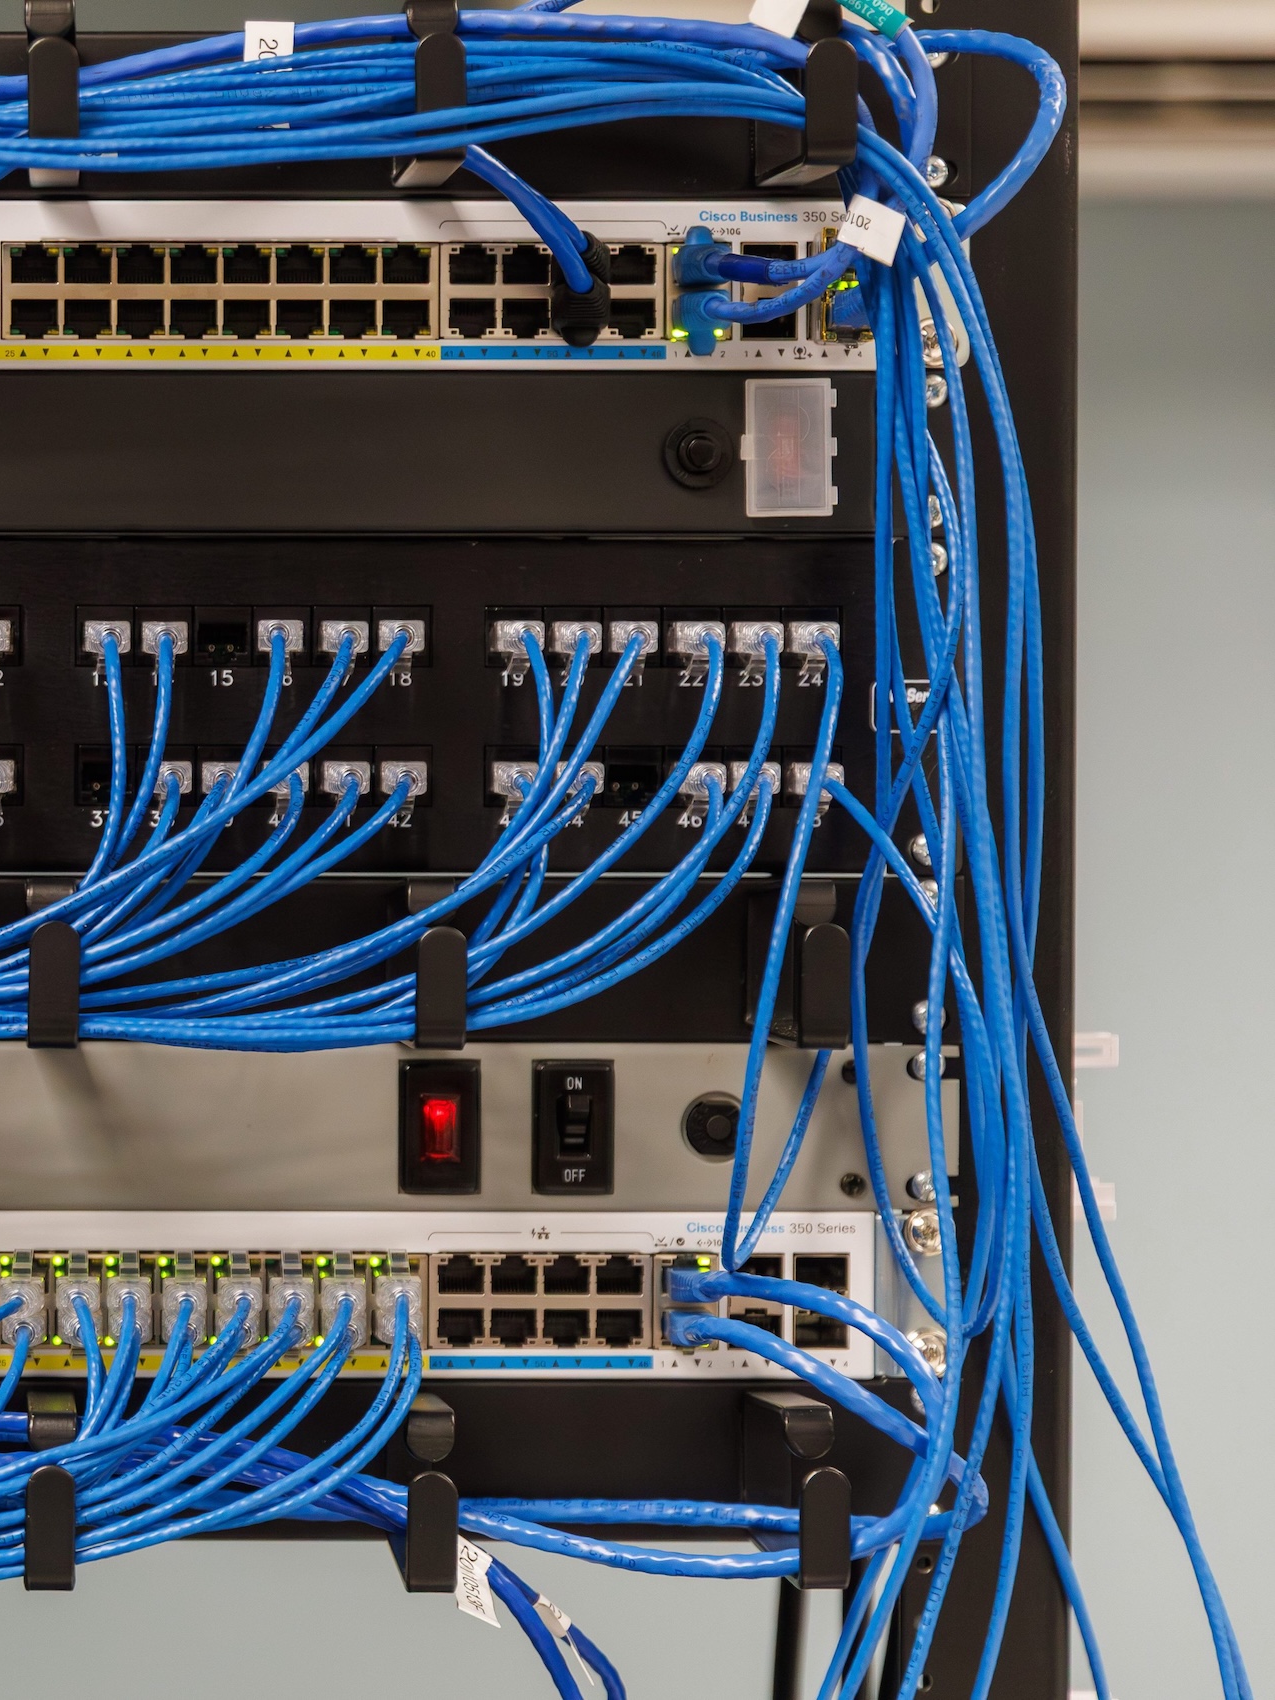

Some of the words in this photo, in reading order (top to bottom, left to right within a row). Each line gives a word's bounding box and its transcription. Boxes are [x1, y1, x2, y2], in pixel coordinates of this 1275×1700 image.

[699, 210, 737, 222] Cisco
[740, 210, 798, 222] Business
[803, 211, 826, 222] 350
[5, 350, 16, 358] 25
[211, 670, 234, 686] 15
[390, 672, 412, 686] 18
[501, 671, 524, 686] 19
[679, 672, 704, 686] 22
[738, 671, 764, 687] 23
[798, 672, 824, 687] 24
[678, 813, 703, 828] 46
[566, 1076, 584, 1091] ON
[564, 1168, 586, 1183] OFF
[686, 1222, 722, 1234] Cisco
[790, 1222, 813, 1234] 350
[818, 1222, 856, 1234] Series
